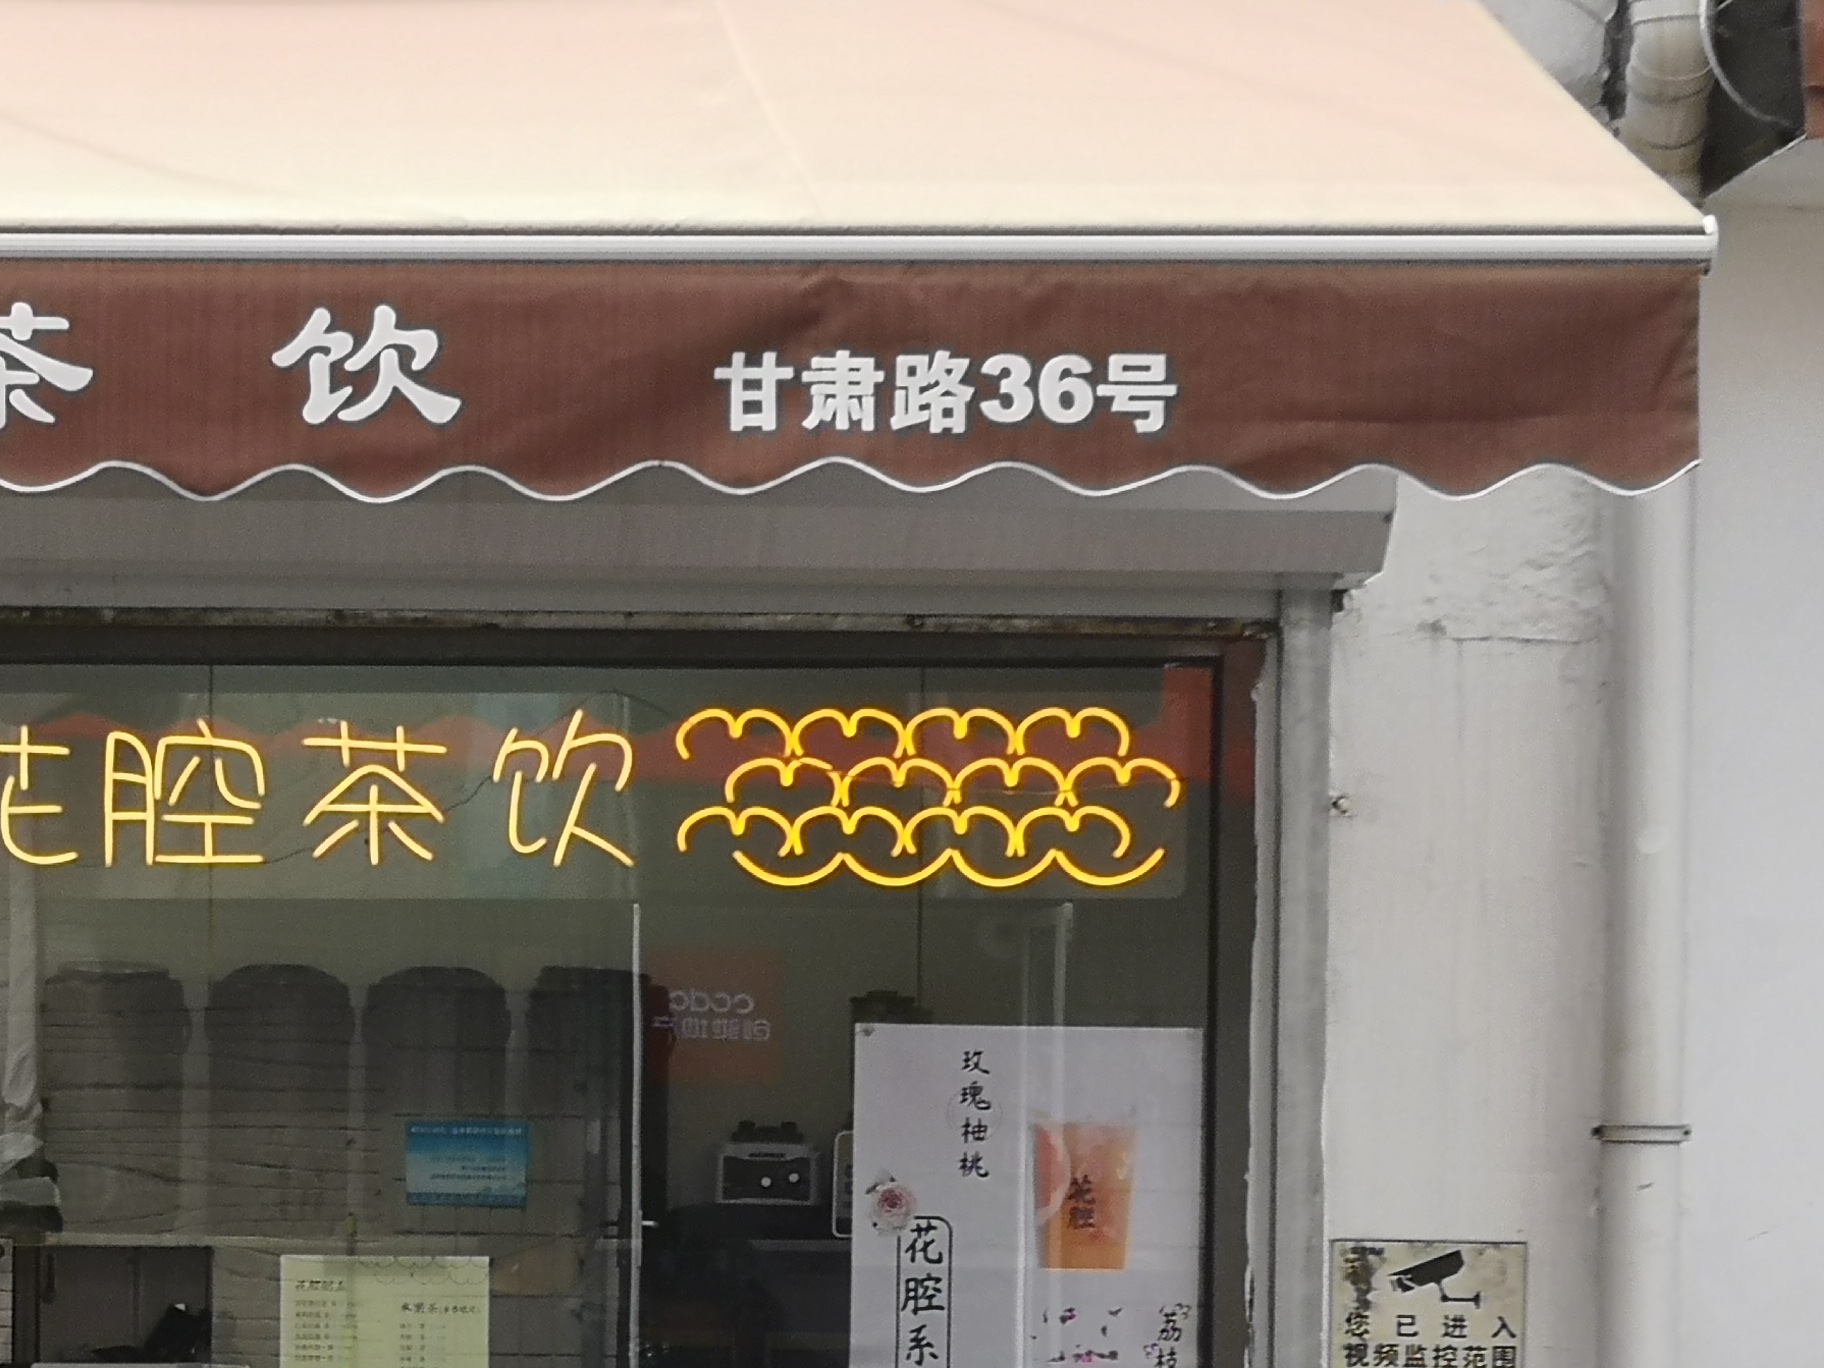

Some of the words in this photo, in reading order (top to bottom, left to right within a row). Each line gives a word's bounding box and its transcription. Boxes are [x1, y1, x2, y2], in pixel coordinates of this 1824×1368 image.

[714, 350, 1177, 433] 甘肃路36号
[959, 1050, 990, 1178] 玫瑰柚桃
[1344, 1311, 1517, 1339] 您已进入
